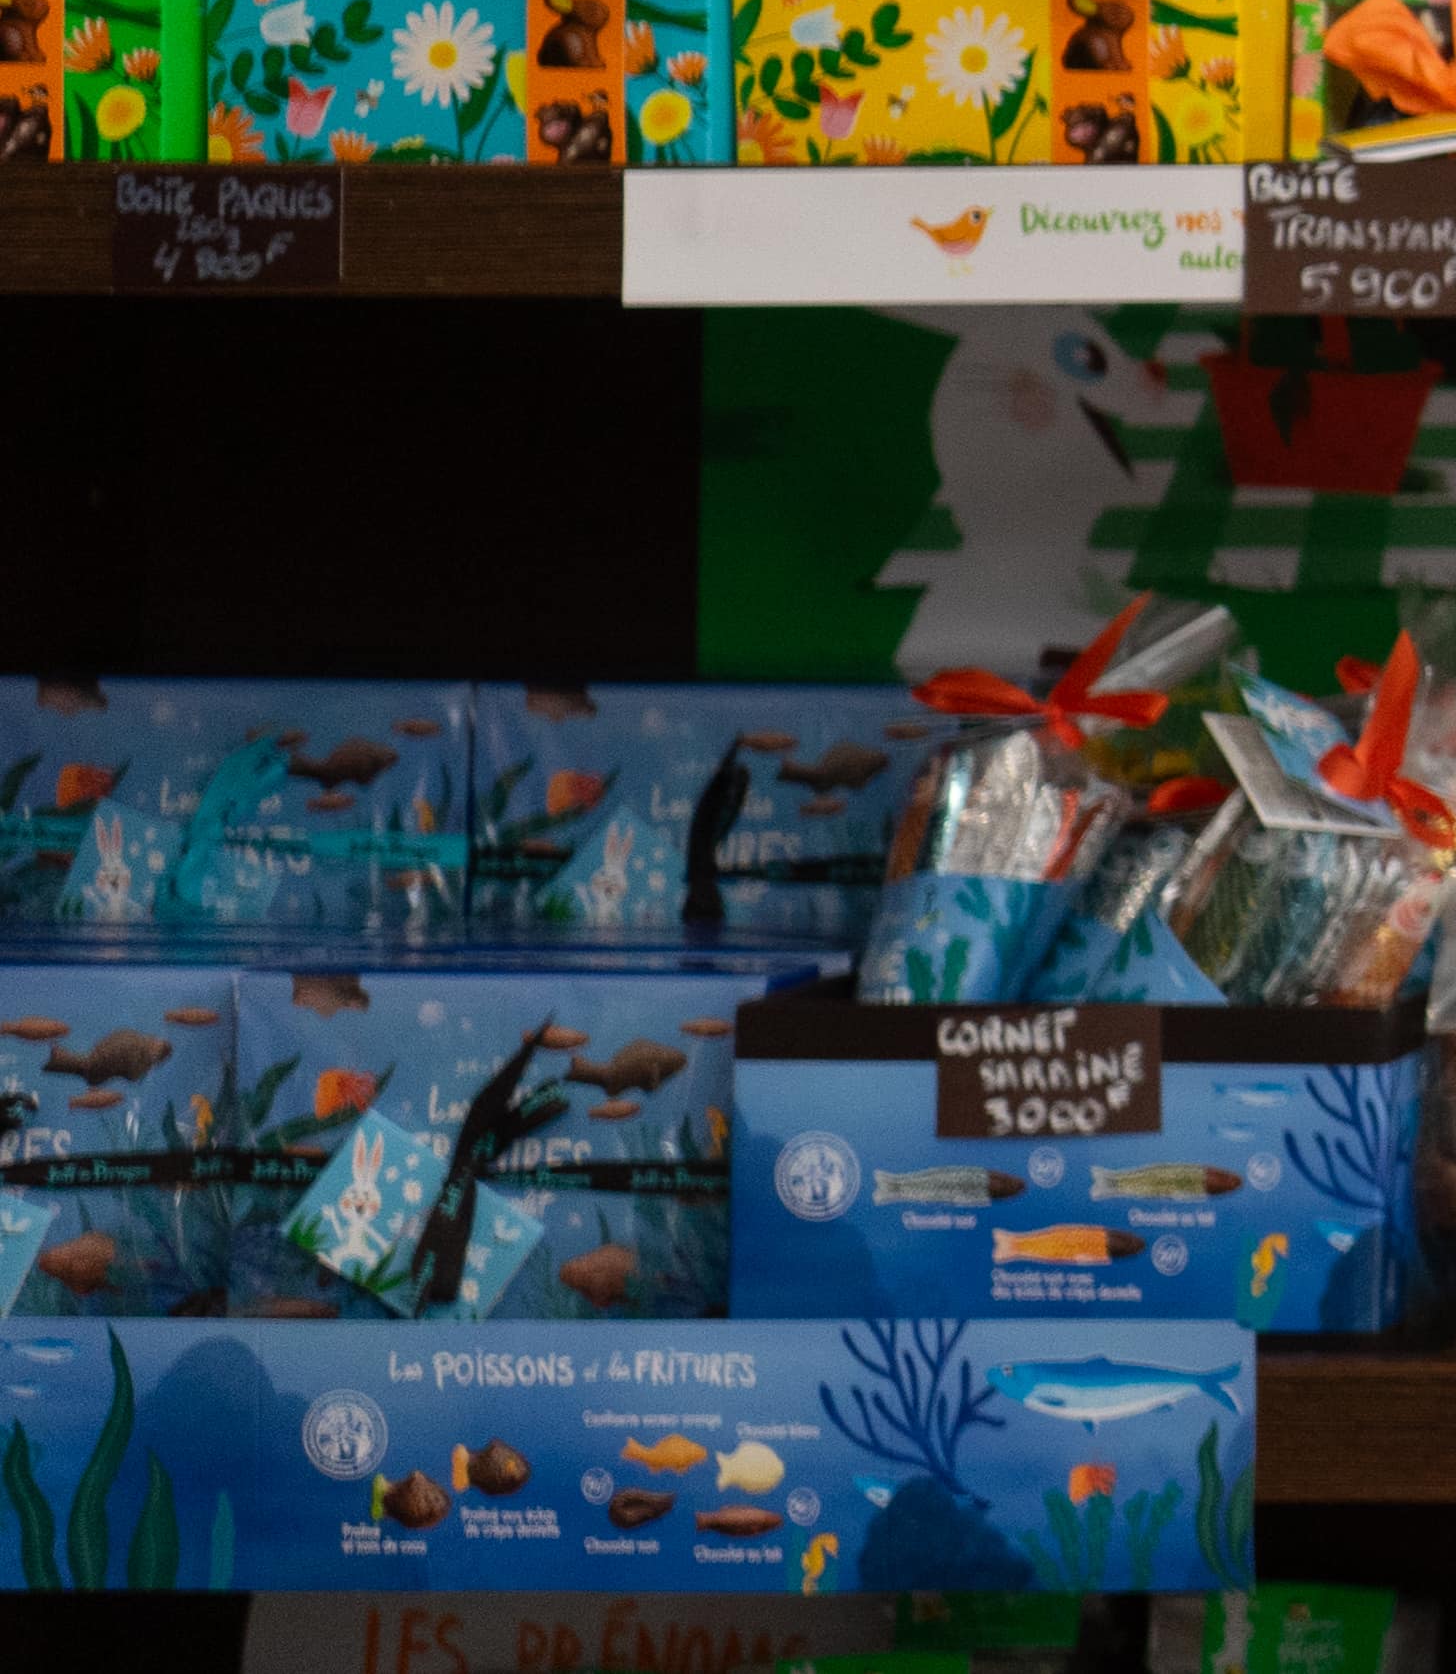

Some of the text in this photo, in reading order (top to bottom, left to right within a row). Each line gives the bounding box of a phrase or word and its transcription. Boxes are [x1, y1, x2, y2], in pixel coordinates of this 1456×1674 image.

[217, 176, 333, 220] PAQUES
[1020, 203, 1166, 248] Découvrez
[937, 1007, 1077, 1057] CORNET
[433, 1348, 574, 1390] POISSONS
[635, 1351, 757, 1388] FRITURES
